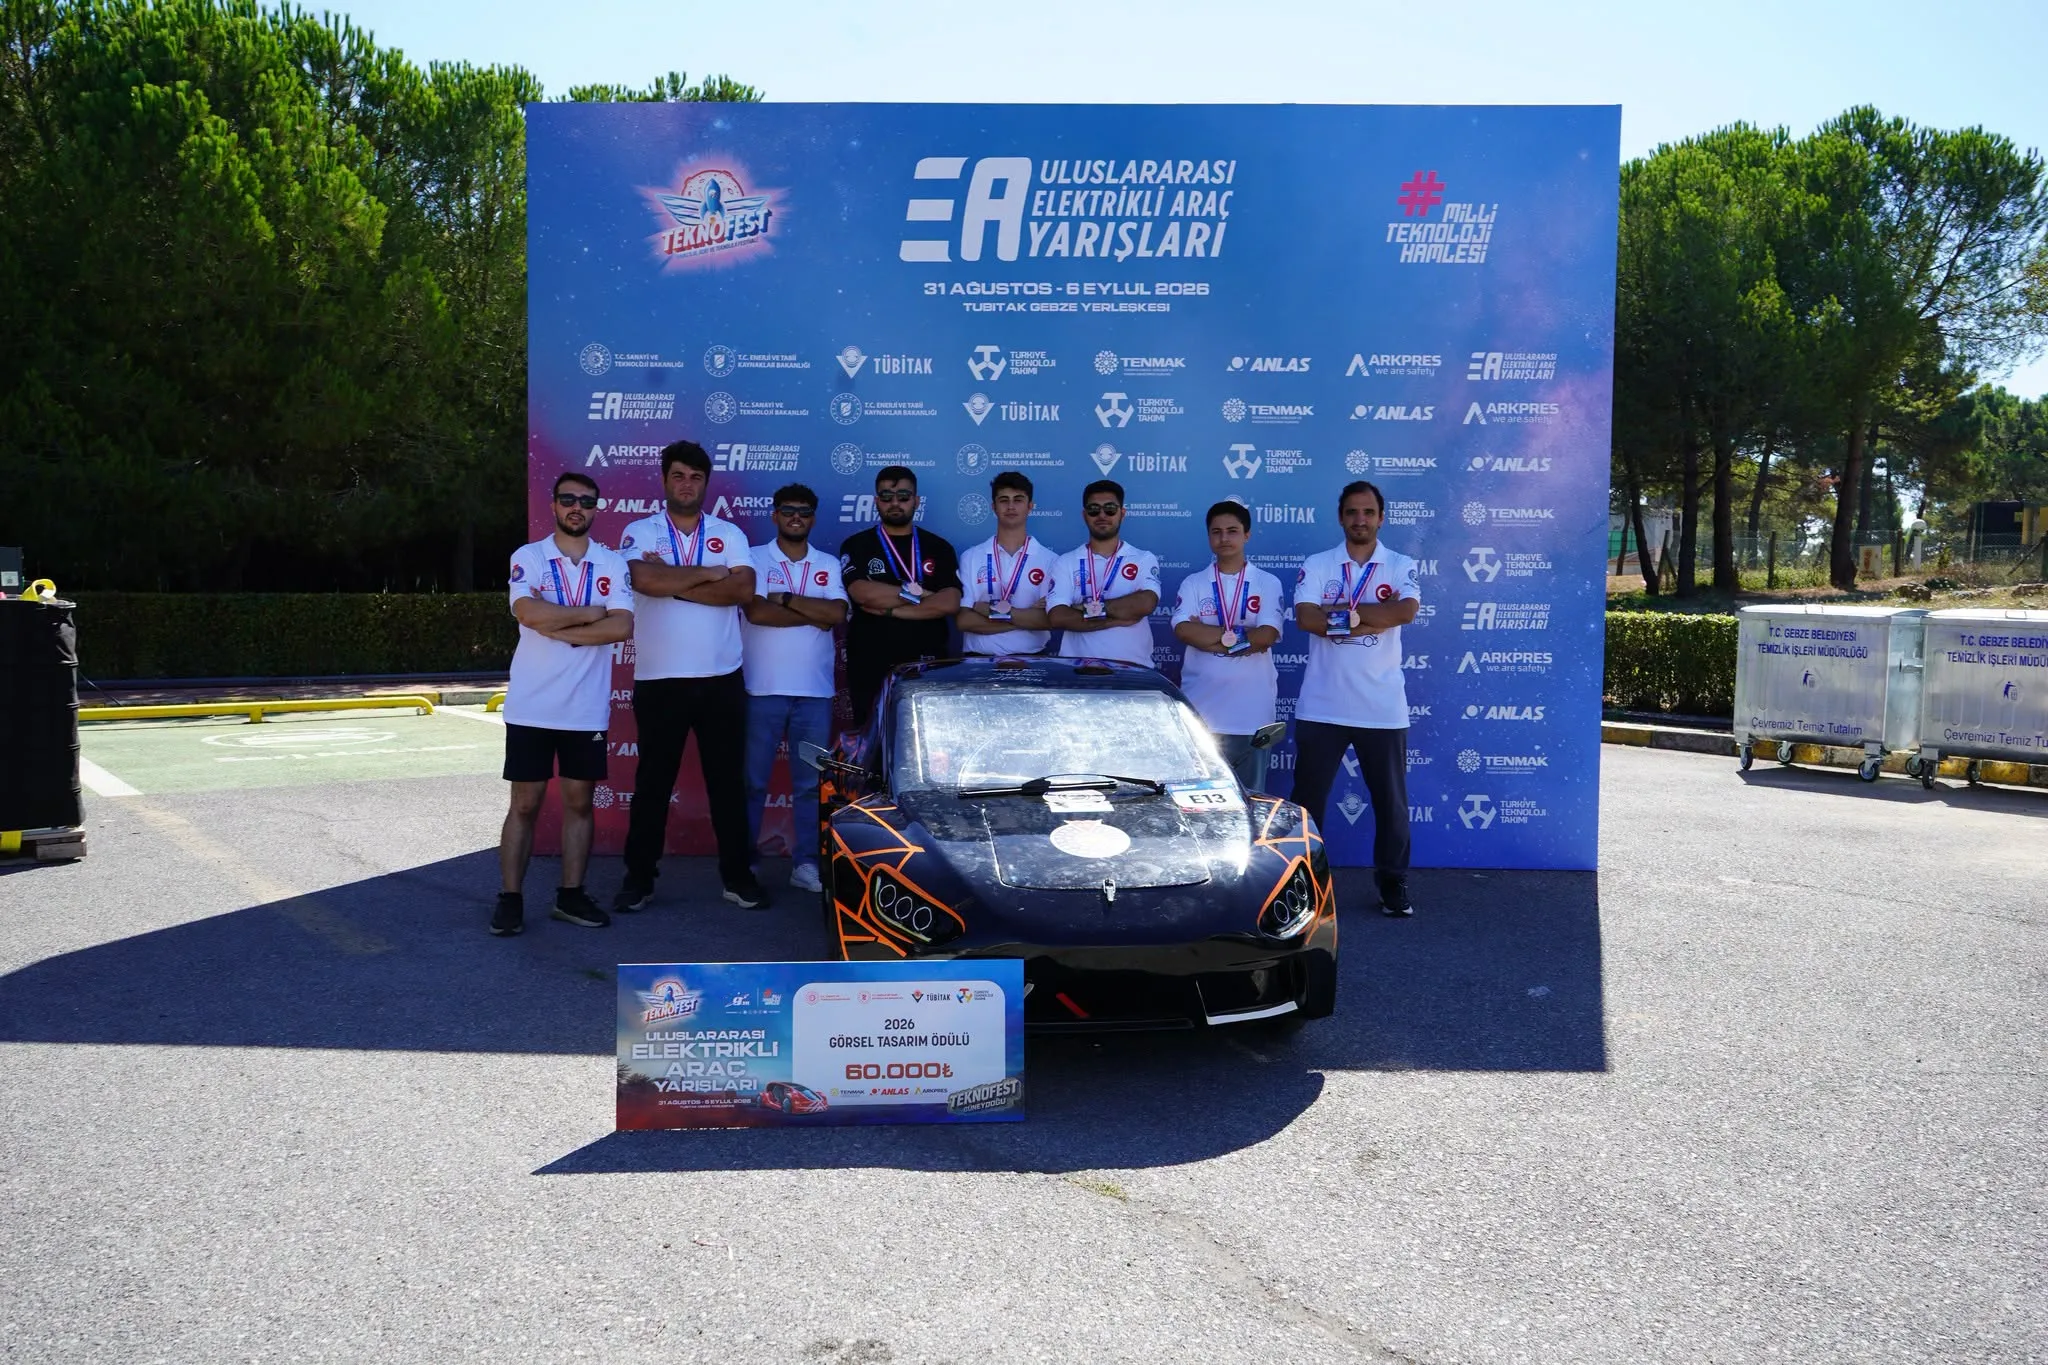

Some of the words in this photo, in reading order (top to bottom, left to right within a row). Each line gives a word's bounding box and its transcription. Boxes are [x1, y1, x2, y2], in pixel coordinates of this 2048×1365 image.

[1040, 159, 1236, 185] ULUSLARARASI
[1031, 185, 1165, 217] ELEKTRİKLİ
[1169, 190, 1234, 221] ARAÇ
[662, 208, 772, 255] TEKNOFEST
[1028, 221, 1227, 263] YARIŞLARI
[923, 283, 946, 296] 31
[950, 281, 1051, 296] AĞUSTOS
[1066, 283, 1079, 296] 6
[1155, 283, 1210, 296] 2026
[1030, 303, 1078, 312] GEBZE
[874, 355, 933, 374] TÜBİTAK
[1120, 357, 1186, 368] TENMAK
[1250, 357, 1312, 372] ANLAS
[1368, 354, 1442, 366] ARKPRES
[1407, 367, 1435, 376] safety
[1000, 401, 1060, 421] TÜBİTAK
[1248, 405, 1314, 416] TENMAK
[1373, 406, 1436, 420] ANLAS
[1486, 403, 1559, 414] ARKPRES
[1524, 415, 1552, 425] safety
[607, 445, 665, 456] ARKPR
[644, 457, 663, 466] safe
[1128, 452, 1188, 472] TÜBİTAK
[1372, 457, 1438, 468] TENMAK
[1491, 457, 1552, 472] ANLAS
[732, 496, 774, 508] ARKP
[1256, 504, 1315, 524] TÜBİTAK
[1488, 508, 1554, 519] TENMAK
[1769, 627, 1783, 637] T.C.
[1785, 628, 1809, 639] GEBZE
[1811, 629, 1857, 641] BELEDİYESİ
[1960, 635, 1976, 646] T.C.
[1979, 636, 2009, 647] GEBZE
[1758, 642, 1790, 655] TEMİZLİK
[1792, 644, 1816, 658] İŞLERİ
[1818, 645, 1868, 659] MÜDÜRLÜĞÜ
[1480, 652, 1553, 664] ARKPRES
[1947, 651, 1985, 664] TEMİZLİK
[1988, 653, 2017, 667] İŞLERİ
[1517, 664, 1545, 674] safety
[1486, 705, 1545, 720] ANLAS
[1752, 717, 1795, 729] Çevremizi
[1798, 720, 1824, 732] Temiz
[1828, 722, 1862, 736] Tutalım
[1943, 729, 1996, 743] Çevremizi
[1999, 733, 2031, 746] Temiz
[1483, 756, 1548, 767] TENMAK
[1188, 793, 1227, 804] E13
[927, 991, 951, 1001] TÜBİTAK
[643, 999, 698, 1023] TEKNOFEST
[884, 1018, 915, 1030] 2026
[646, 1030, 765, 1041] ULUSLARARASI
[829, 1034, 874, 1048] GÖRSEL
[877, 1035, 928, 1047] TASARIM
[932, 1032, 970, 1046] ÖDÜLÜ
[665, 1060, 746, 1079] ARAÇ
[653, 1079, 758, 1093] YARIŞLARI
[949, 1079, 1019, 1108] TEKNOFEST
